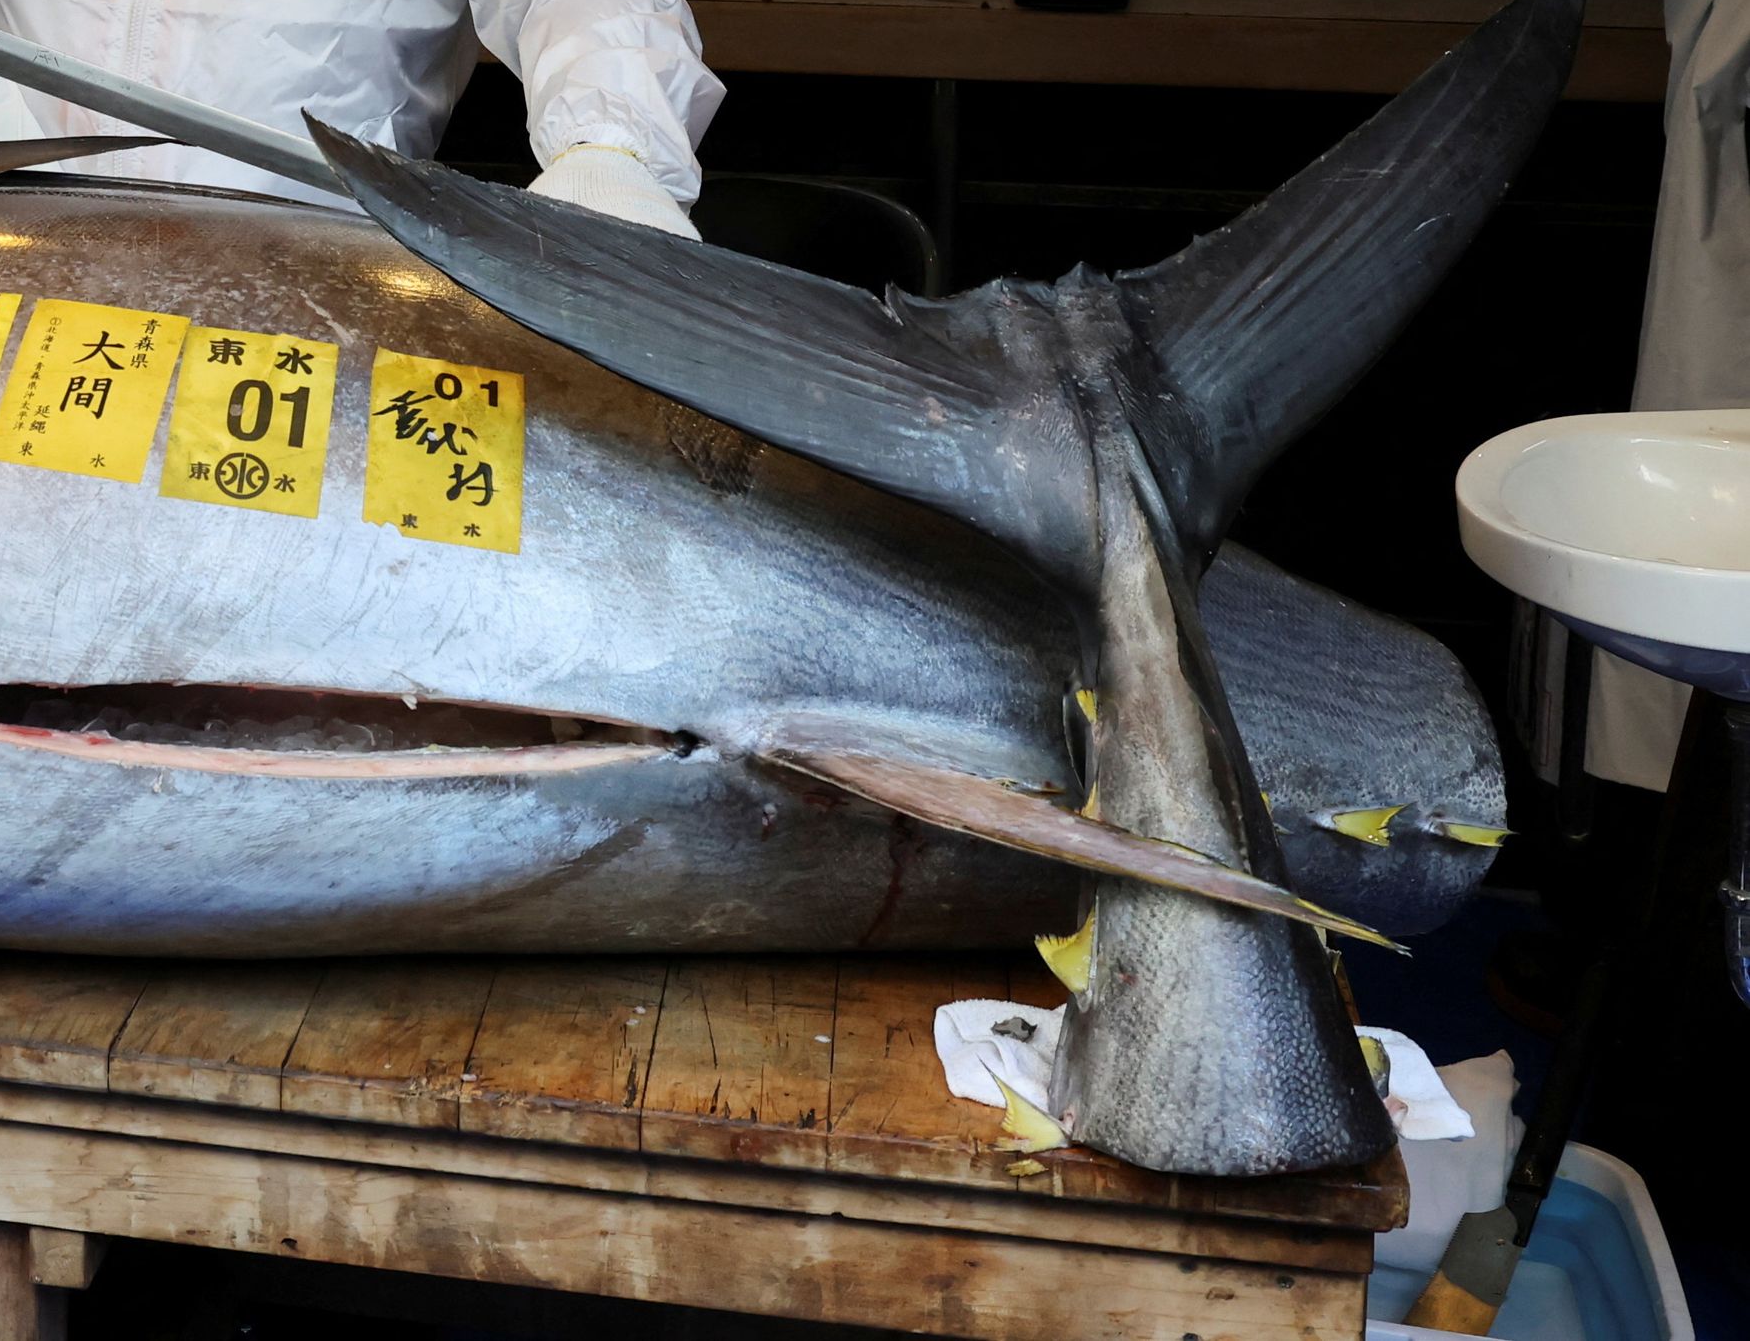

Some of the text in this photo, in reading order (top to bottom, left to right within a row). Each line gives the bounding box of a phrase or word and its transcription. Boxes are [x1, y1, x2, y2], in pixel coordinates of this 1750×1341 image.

[59, 331, 126, 420] 大間
[130, 318, 161, 369] 青森県
[226, 379, 311, 449] 01
